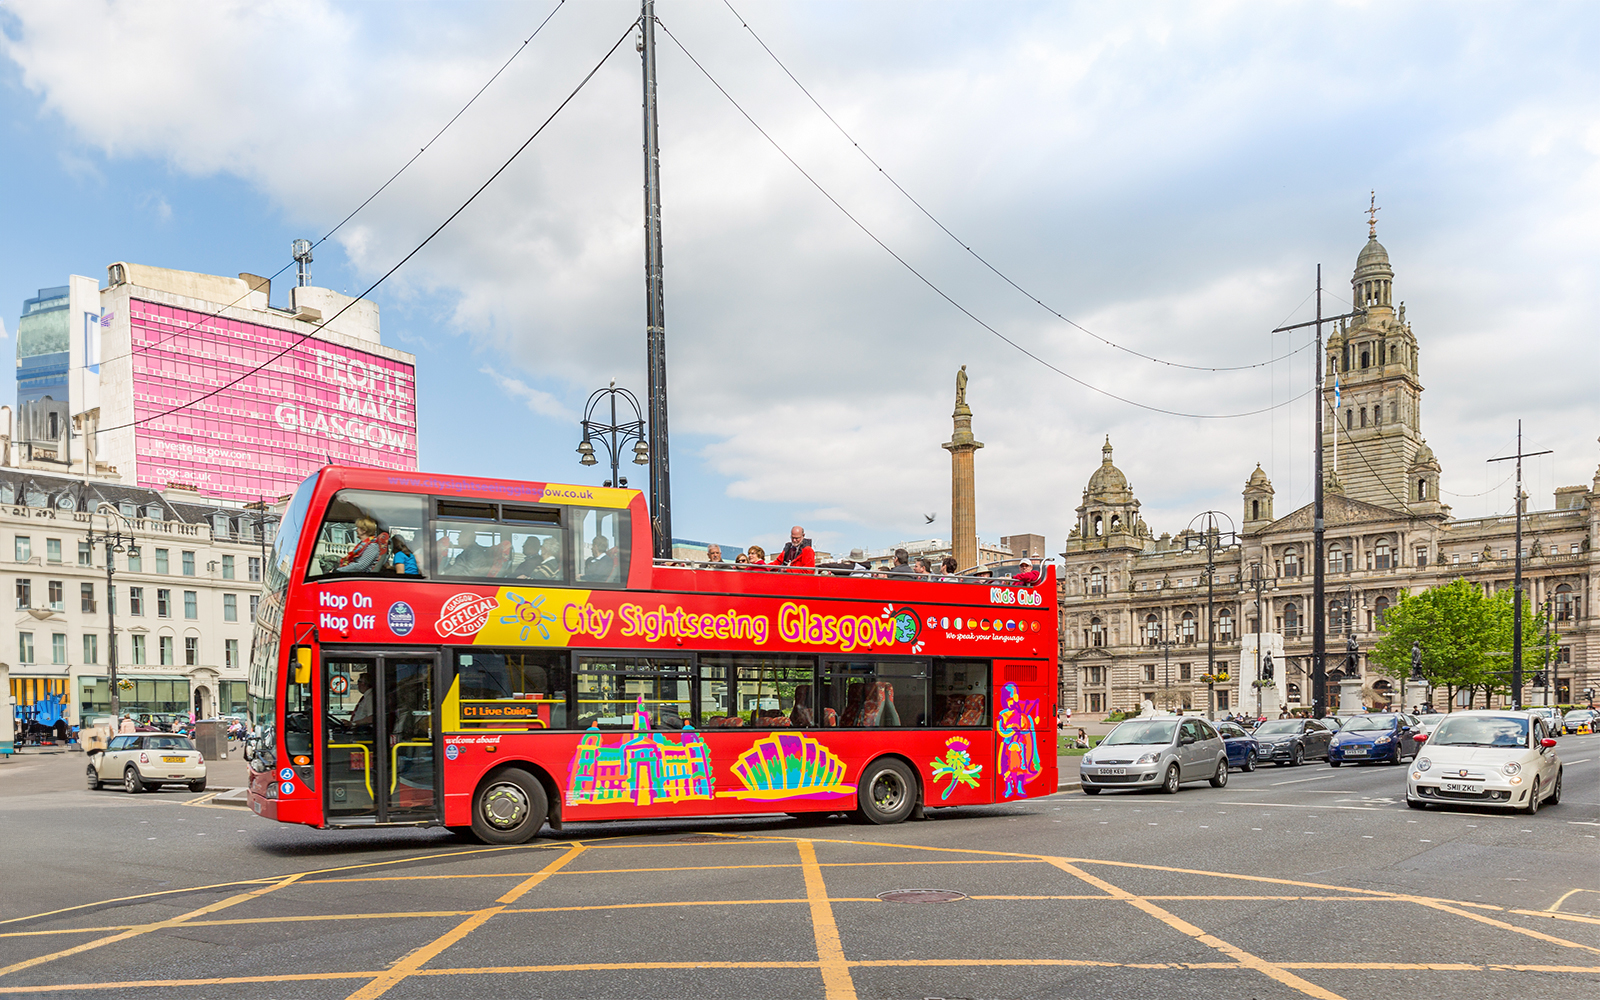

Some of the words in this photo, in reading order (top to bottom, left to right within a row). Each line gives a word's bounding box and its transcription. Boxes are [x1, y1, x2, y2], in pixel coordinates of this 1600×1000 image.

[316, 350, 408, 398] PEOPLE
[338, 386, 408, 425] MAKE
[274, 402, 408, 453] GLASGOW
[155, 440, 251, 460] investglasgow.com
[156, 467, 212, 481] cogc.ac.uk
[387, 475, 594, 500] www.citysightseeingglasgow.co.uk
[319, 591, 349, 610] Hop
[352, 592, 373, 609] On
[447, 595, 473, 611] GLASGOW
[990, 587, 1015, 604] Kids
[1017, 588, 1042, 606] Club
[320, 613, 349, 632] Hop
[352, 613, 376, 630] Off
[441, 599, 496, 631] OFFICIAL
[462, 616, 486, 632] TOUR
[562, 602, 613, 639] City
[618, 602, 769, 645] Sightseeing
[777, 601, 897, 652] Glasgow
[956, 633, 976, 641] speak
[992, 633, 1024, 643] language
[479, 707, 502, 716] Live
[504, 707, 533, 716] Guide
[445, 735, 475, 744] welcome
[476, 735, 502, 743] aboard
[298, 756, 305, 764] 4
[1462, 784, 1477, 792] ZKL
